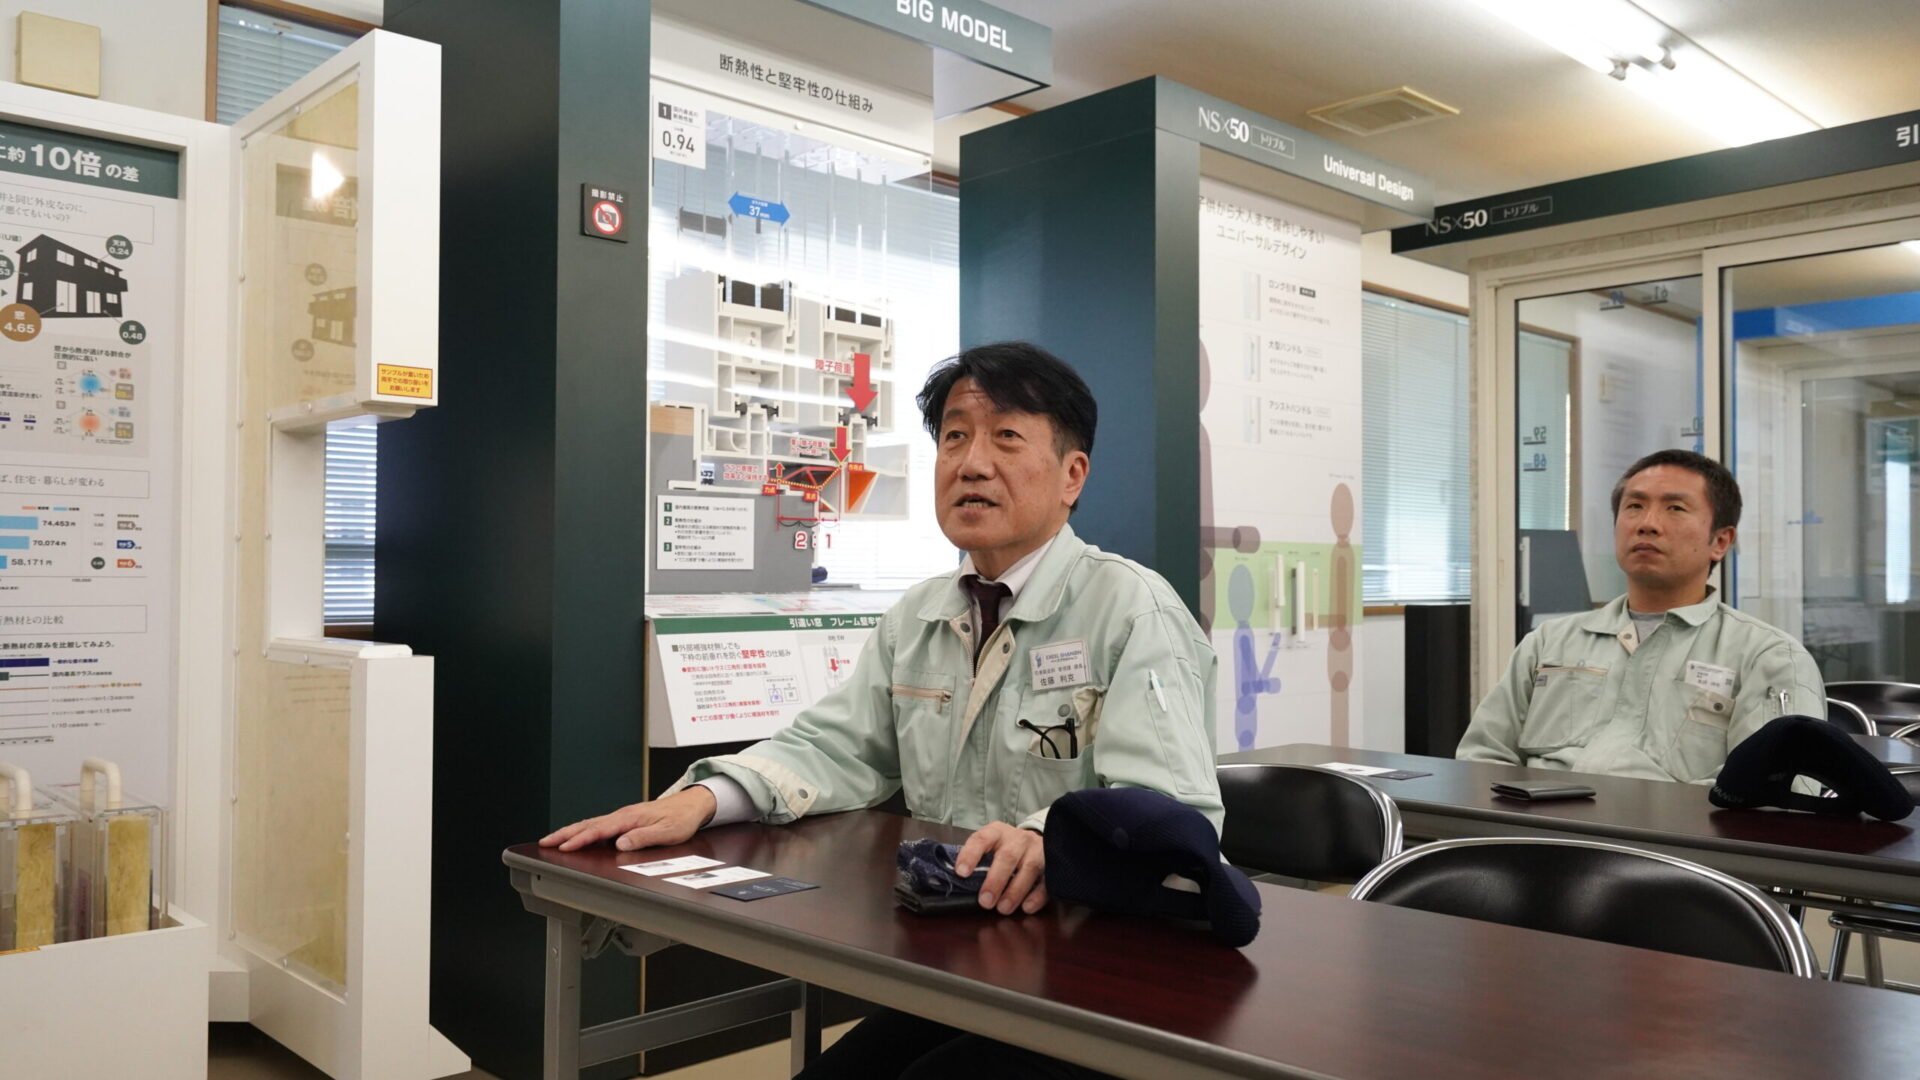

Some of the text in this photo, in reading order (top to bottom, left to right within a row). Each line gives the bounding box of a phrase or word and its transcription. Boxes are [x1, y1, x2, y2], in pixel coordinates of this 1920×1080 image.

[897, 0, 1013, 53] BIG MODEL
[719, 53, 874, 113] 断熱性と堅牢性の仕組み
[663, 130, 695, 153] 0.94
[1896, 123, 1919, 148] 引
[1324, 154, 1414, 201] Universal Design
[591, 188, 624, 203] 撮影禁止
[1503, 203, 1539, 219] トリプル
[1216, 225, 1307, 259] ユニバーサルデザイン
[108, 246, 130, 256] 0.24
[4, 322, 36, 334] 4.65
[122, 331, 143, 340] 0.48
[789, 618, 822, 629] 引違い窓
[0, 640, 114, 650] 断熱材の厚みを比較してみよう。
